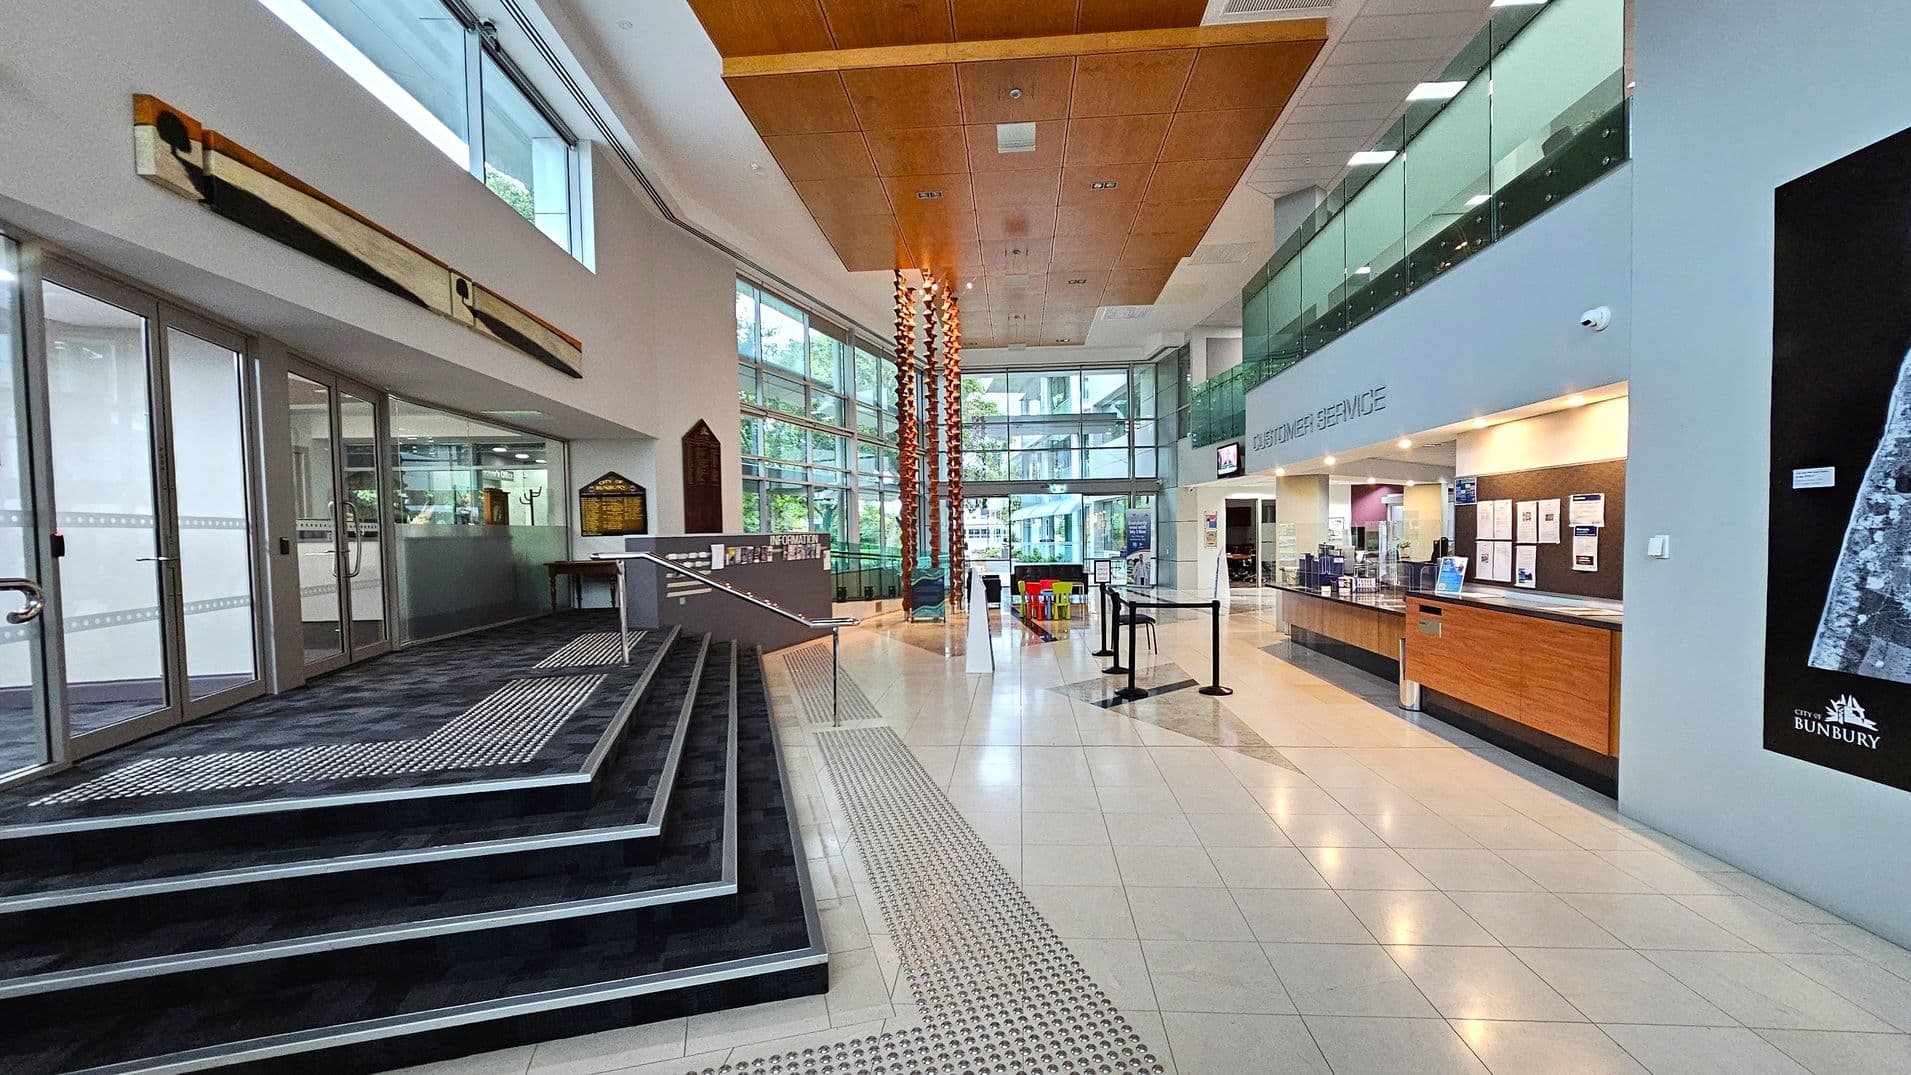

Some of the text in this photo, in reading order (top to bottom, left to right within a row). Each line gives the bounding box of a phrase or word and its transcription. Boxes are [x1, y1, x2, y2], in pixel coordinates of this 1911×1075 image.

[1252, 386, 1386, 451] CUSTOMER SERVICE
[770, 535, 819, 546] INFORMATION
[1794, 708, 1813, 718] CITY
[1794, 716, 1881, 749] BUNBURY
